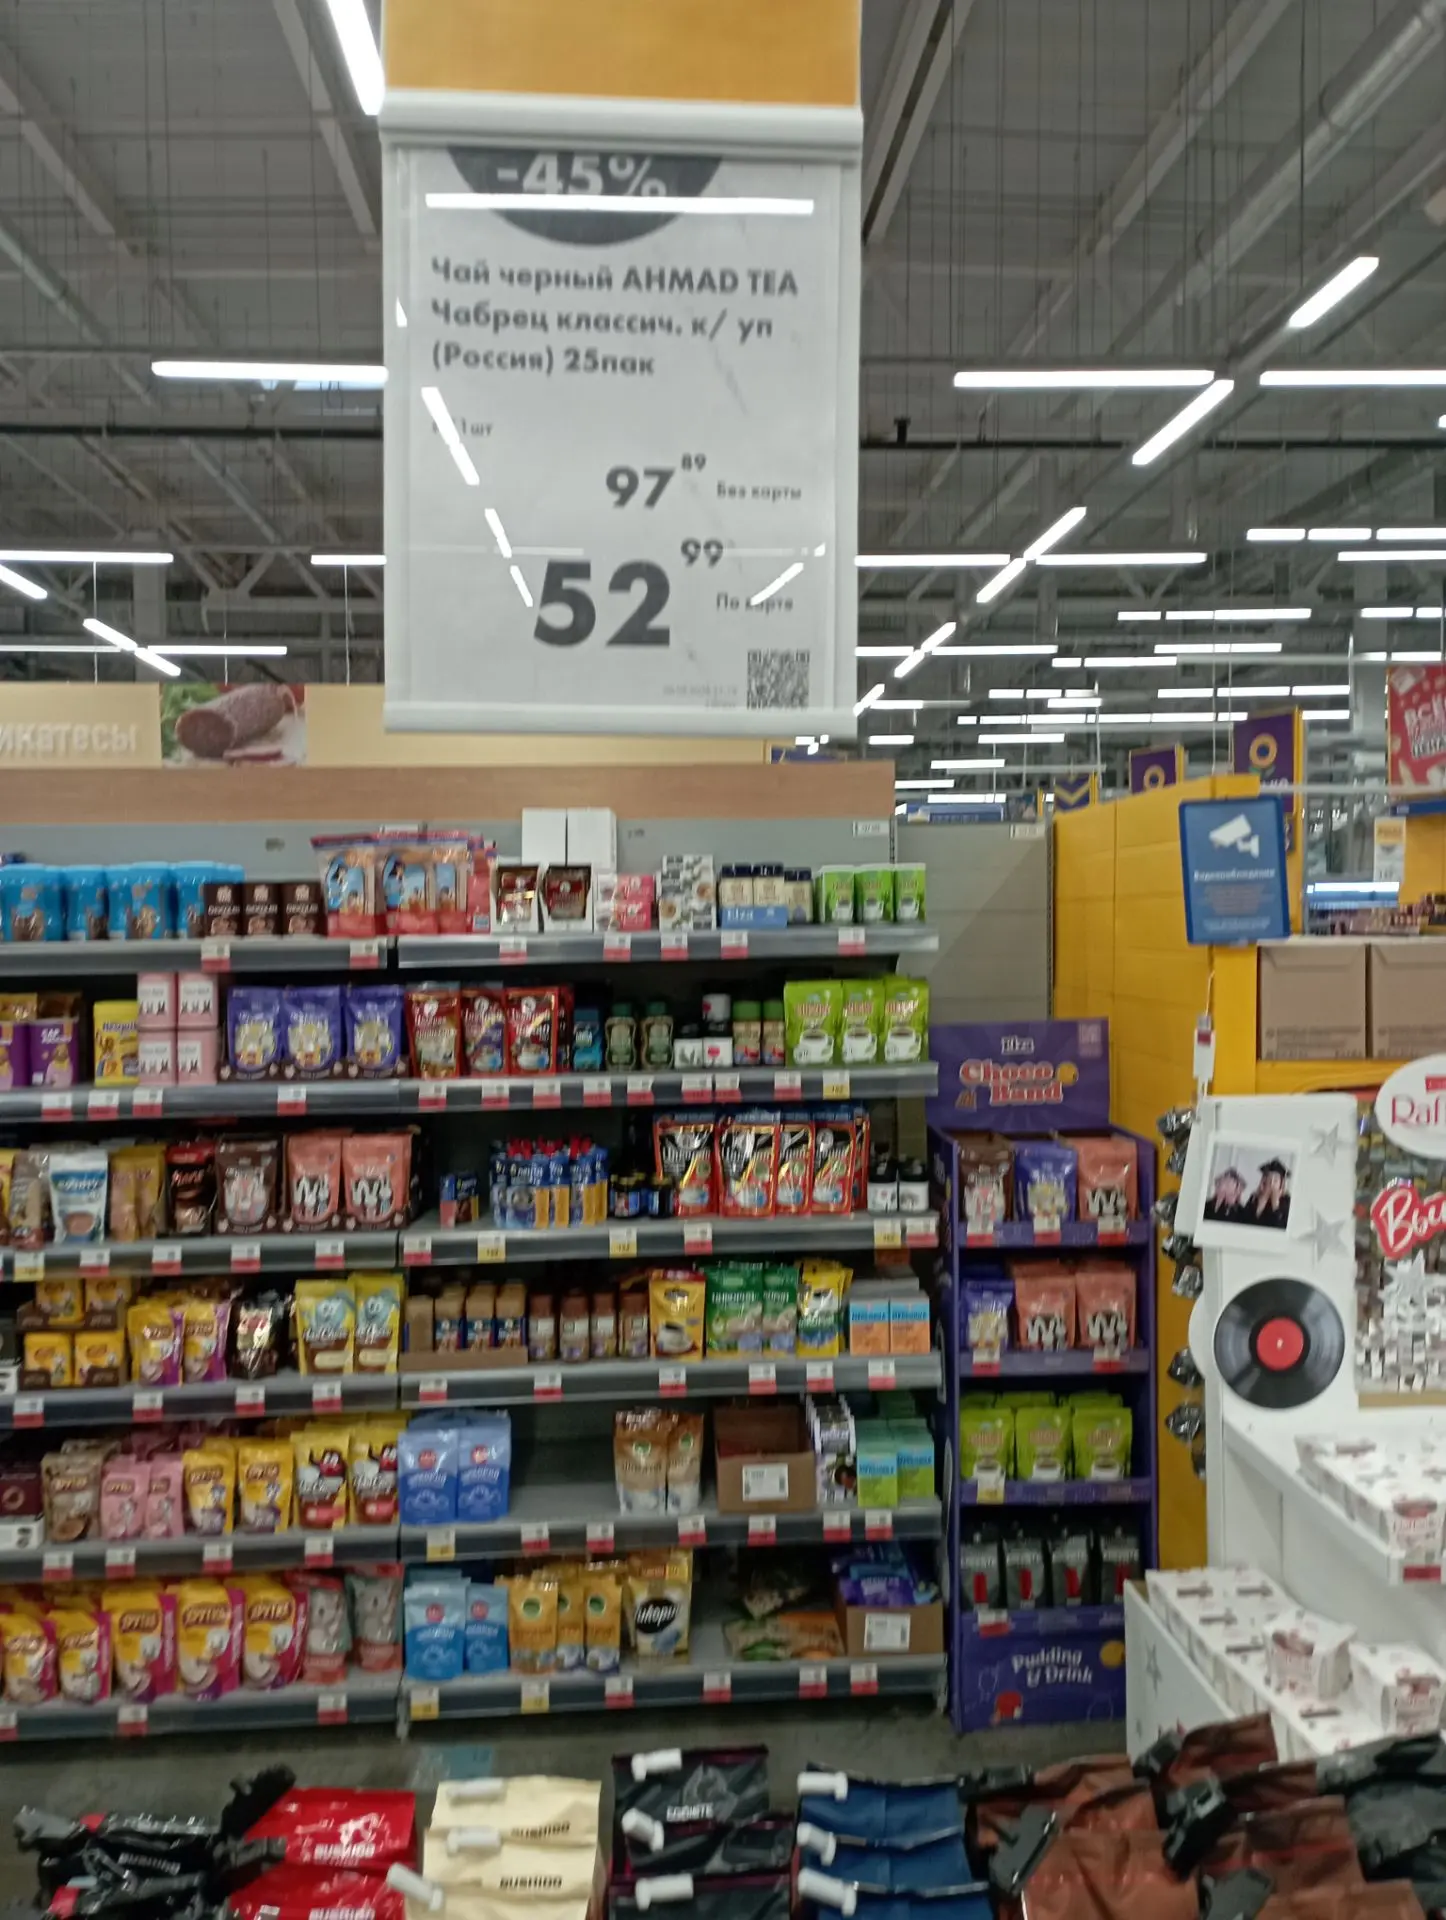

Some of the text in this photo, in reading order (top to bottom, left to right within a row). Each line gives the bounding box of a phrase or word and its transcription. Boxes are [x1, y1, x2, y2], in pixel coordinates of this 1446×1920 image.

[497, 154, 666, 199] -45%
[432, 257, 799, 298] Чай черный AHMAD TEA
[432, 299, 550, 336] Чабрец
[557, 312, 683, 339] классич.
[433, 340, 656, 379] (Россия) 25пак
[606, 453, 709, 511] 97 89
[717, 480, 802, 504] Без карты
[530, 537, 725, 650] 52 99
[716, 592, 740, 612] По
[1391, 1096, 1446, 1127] Raf
